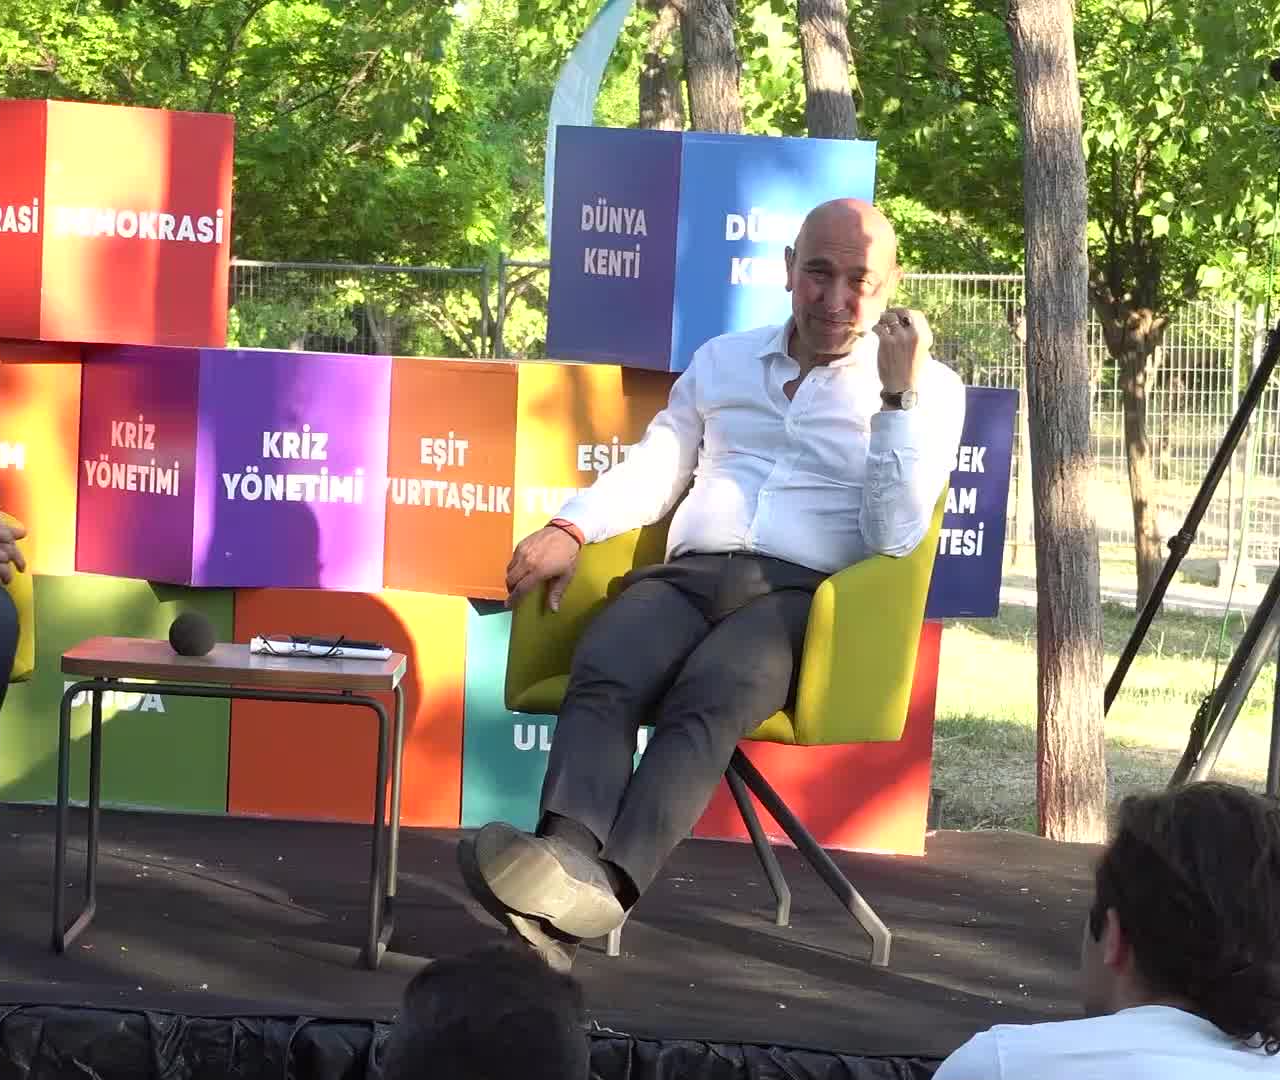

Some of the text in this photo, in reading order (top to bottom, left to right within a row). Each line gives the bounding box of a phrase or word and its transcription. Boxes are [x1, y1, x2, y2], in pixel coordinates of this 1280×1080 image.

[56, 207, 224, 245] DEMOKRASİ
[581, 198, 648, 237] DÜNYA
[584, 243, 641, 279] KENTİ
[111, 413, 156, 451] KRİZ
[263, 423, 329, 461] KRİZ
[420, 431, 469, 472] EŞİT
[84, 453, 179, 497] YÖNETİMİ
[222, 465, 365, 505] YÖNETİMİ
[939, 521, 984, 556] TESİ
